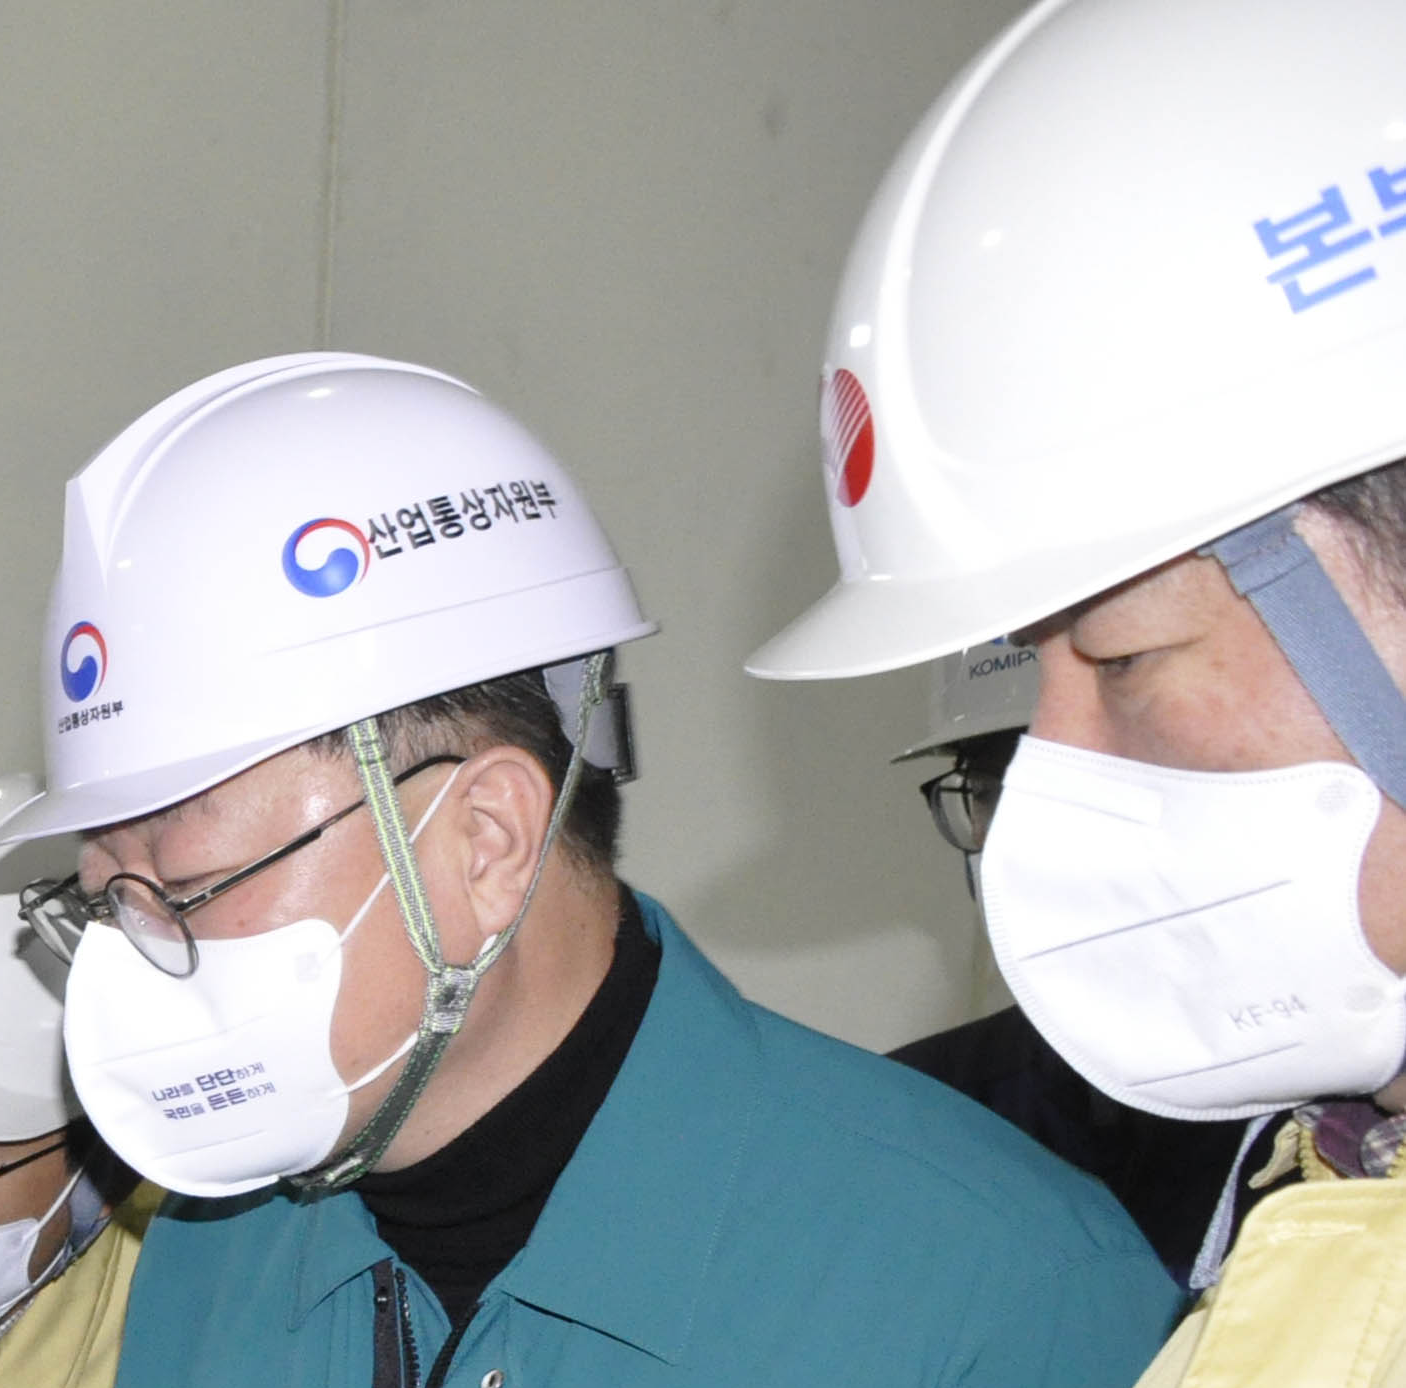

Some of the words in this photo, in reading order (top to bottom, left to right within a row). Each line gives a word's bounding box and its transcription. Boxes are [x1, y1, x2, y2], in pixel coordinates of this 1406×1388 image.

[368, 480, 558, 559] 산업통상자원부
[151, 1083, 195, 1101] 나라를
[195, 1062, 265, 1092] 단단하게
[163, 1102, 206, 1120] 국민을
[207, 1082, 277, 1111] 든든하게
